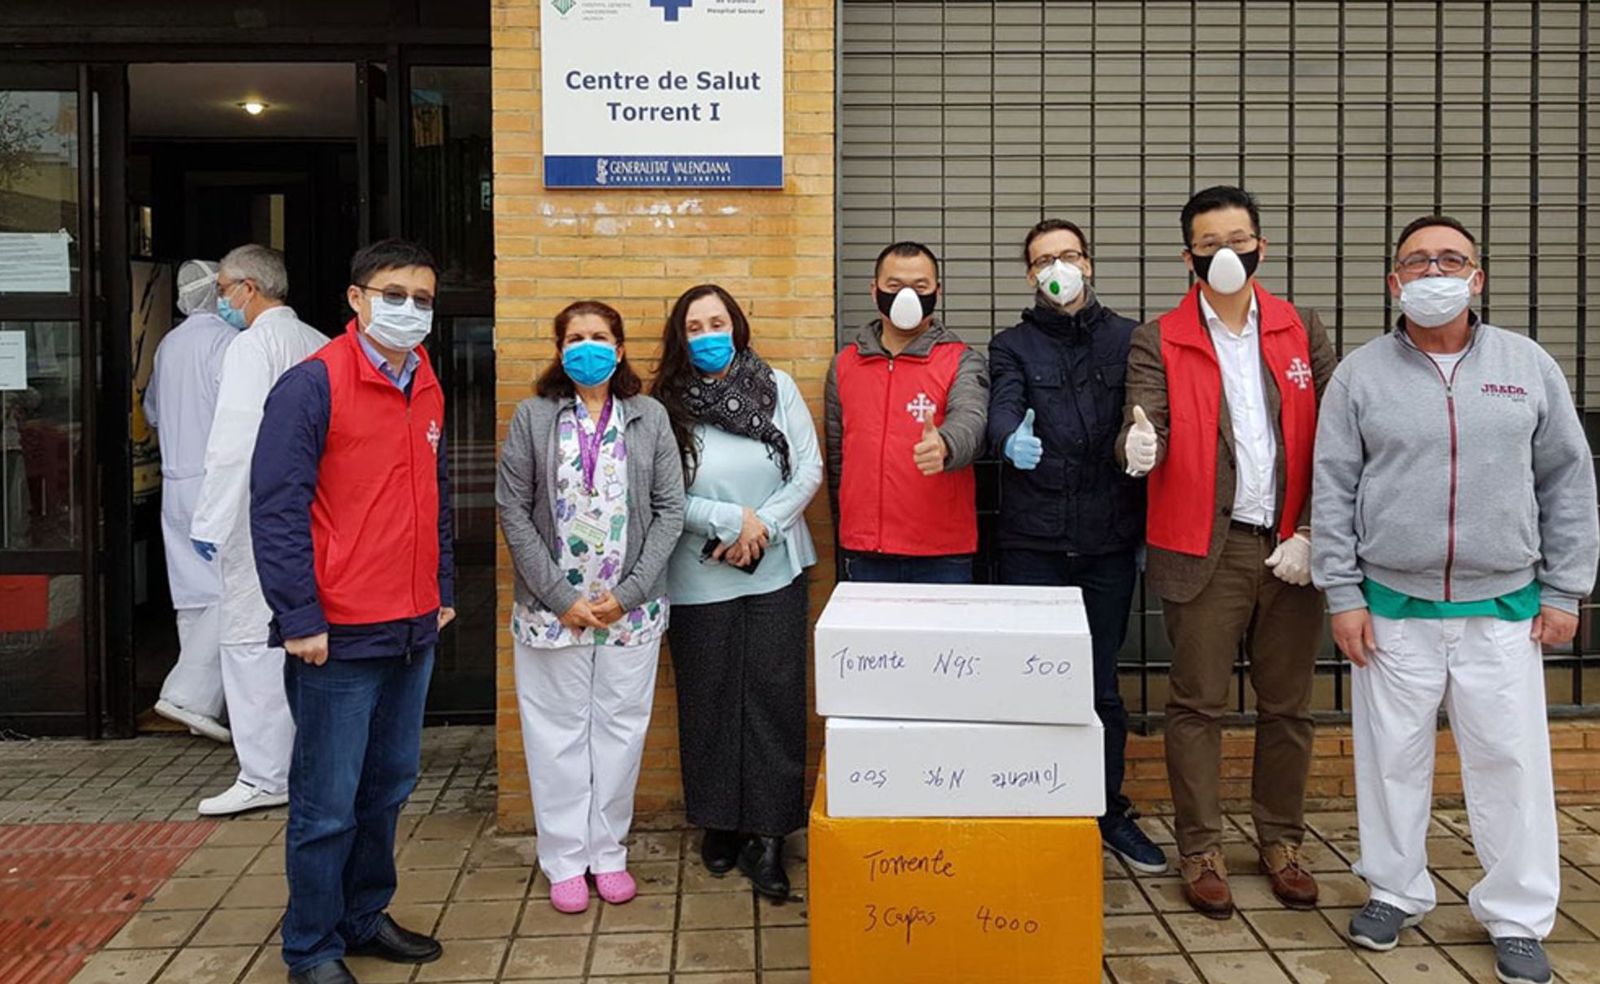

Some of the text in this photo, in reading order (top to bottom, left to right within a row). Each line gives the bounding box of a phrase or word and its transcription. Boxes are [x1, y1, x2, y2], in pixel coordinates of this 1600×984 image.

[566, 70, 761, 91] Centre de Salut
[606, 102, 720, 122] Torrent I
[610, 160, 731, 174] GENERALITAT VALENCIANA
[832, 647, 906, 679] Torrente
[1022, 653, 1071, 676] 500
[849, 769, 887, 788] 500
[991, 762, 1067, 794] Torrente
[863, 850, 955, 882] Torrente
[864, 904, 877, 932] 3
[976, 905, 1039, 934] 4000
